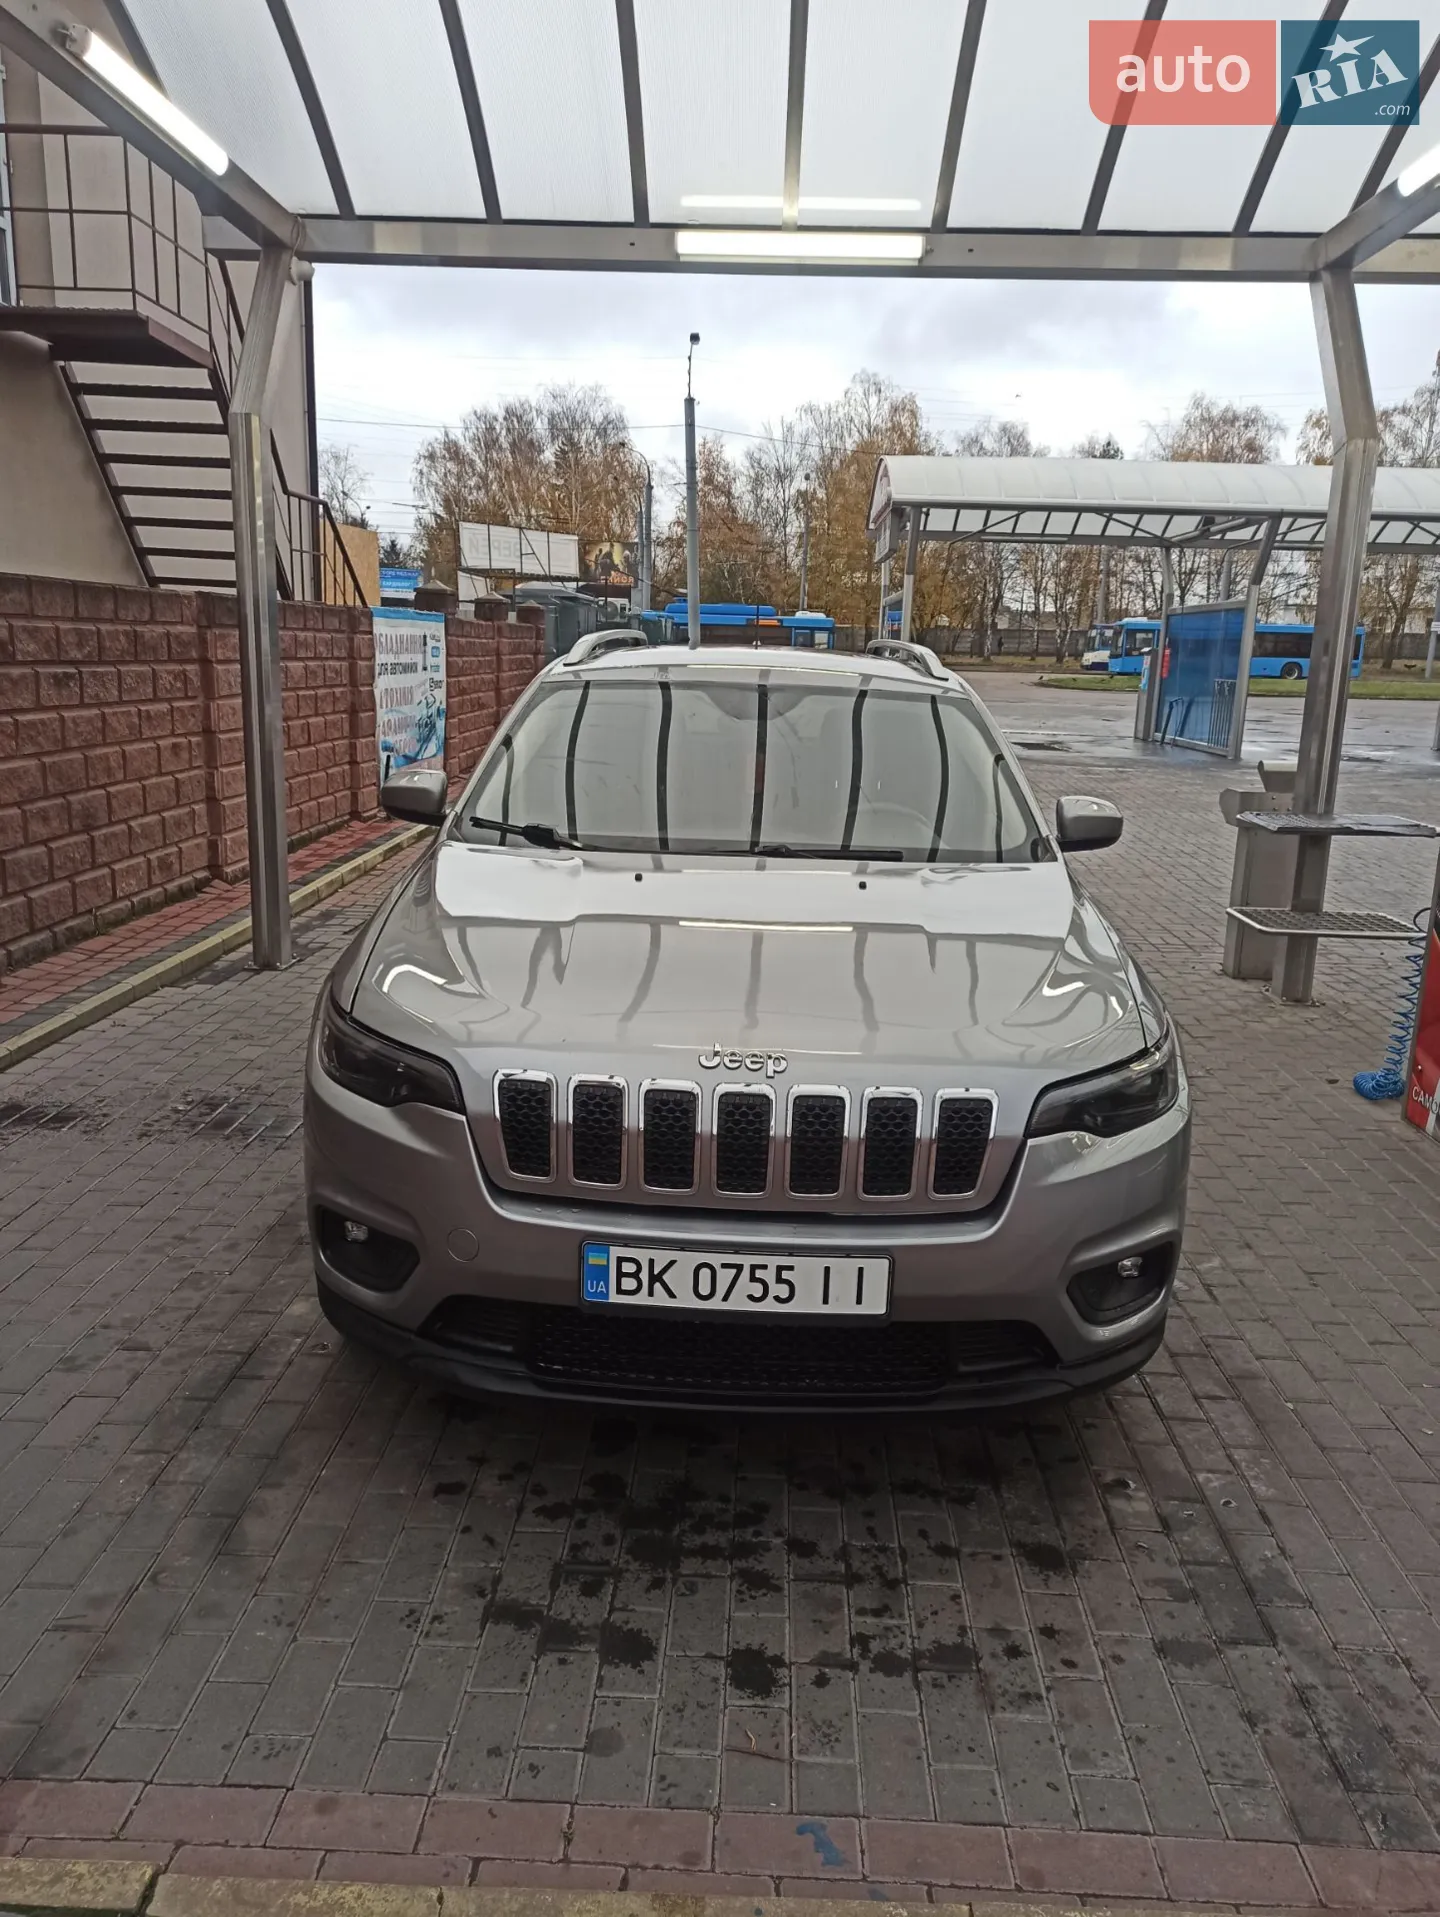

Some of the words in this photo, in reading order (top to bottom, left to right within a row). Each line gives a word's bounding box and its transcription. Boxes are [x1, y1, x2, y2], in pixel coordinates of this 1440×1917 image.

[698, 1042, 788, 1079] Jeep
[587, 1279, 607, 1294] UA
[615, 1255, 678, 1299] BK
[692, 1261, 796, 1304] 0755
